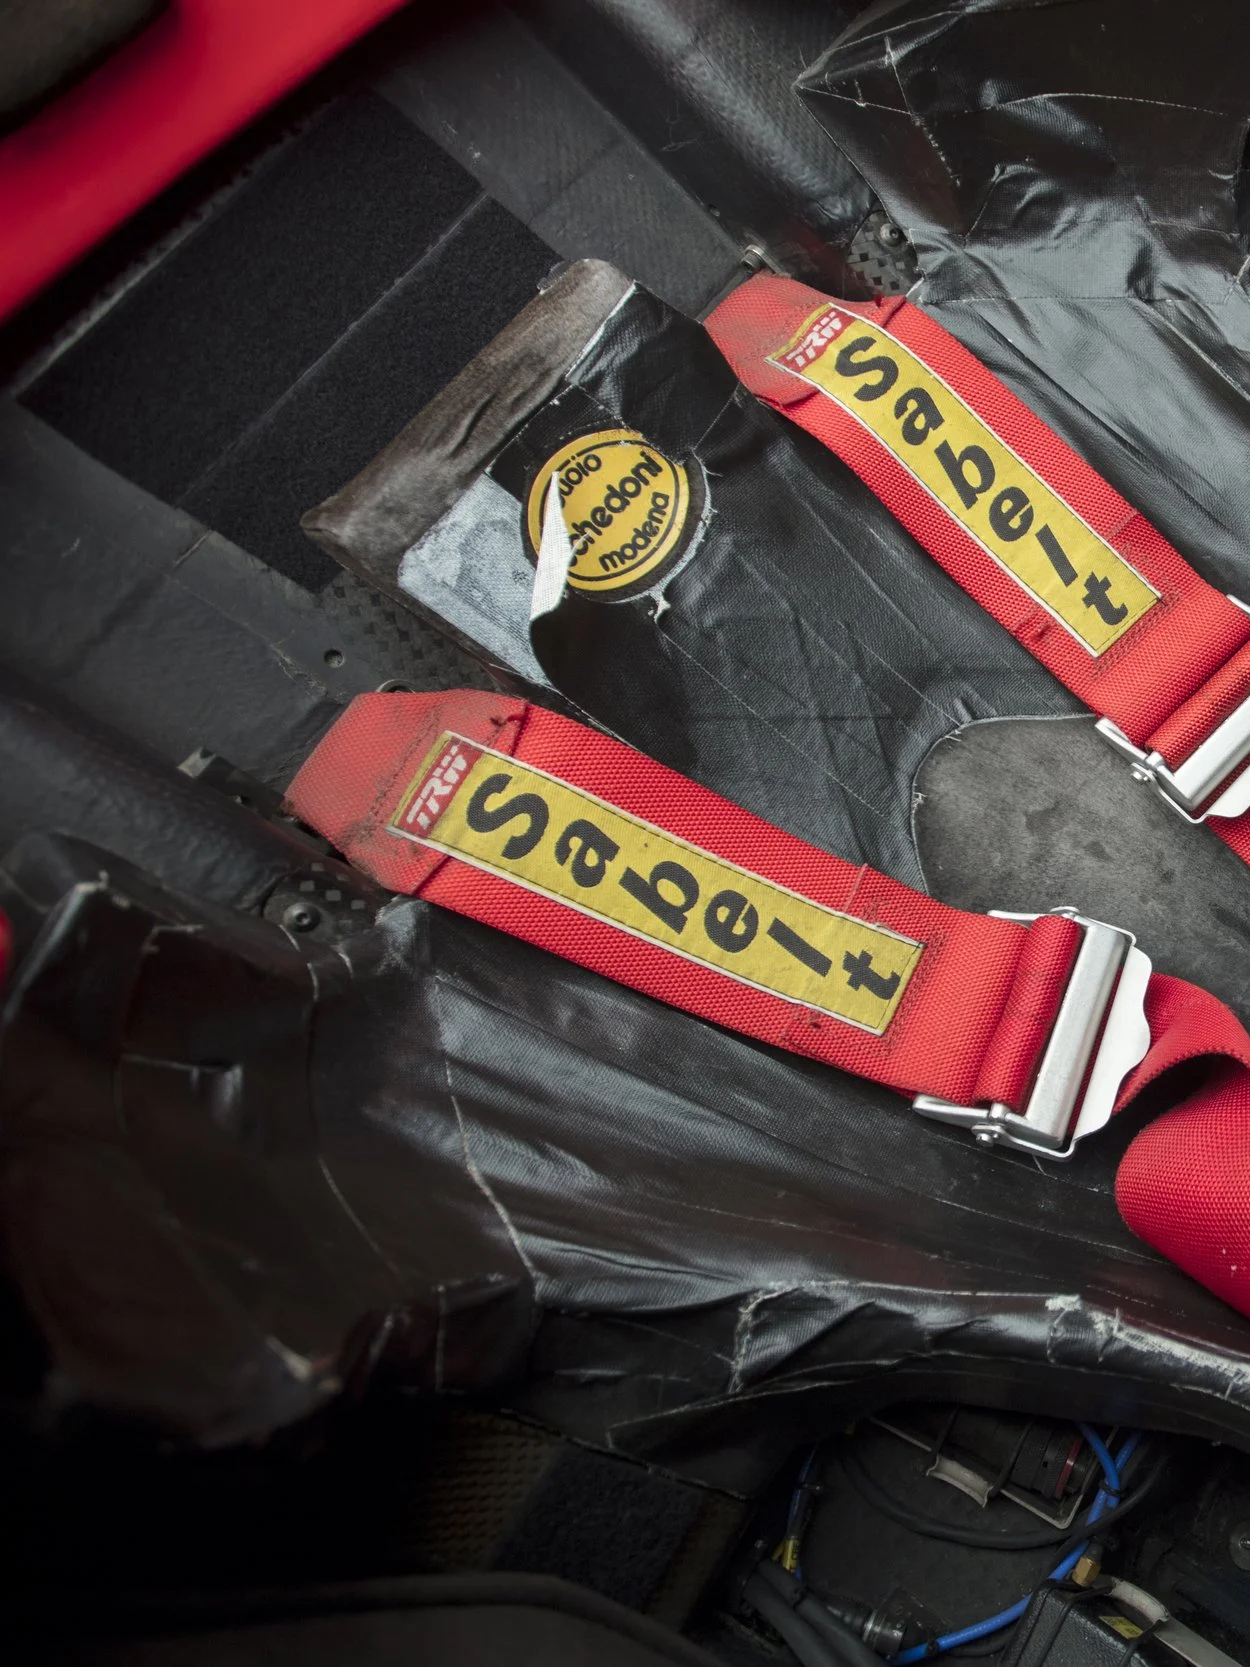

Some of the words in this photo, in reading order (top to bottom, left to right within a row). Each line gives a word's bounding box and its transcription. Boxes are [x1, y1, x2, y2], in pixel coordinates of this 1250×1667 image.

[786, 311, 843, 368] TRW
[567, 450, 663, 567] chedoni
[598, 491, 670, 572] modena
[835, 335, 1129, 627] Sabelt
[406, 745, 468, 830] TRW
[466, 772, 901, 1001] Sabelt
